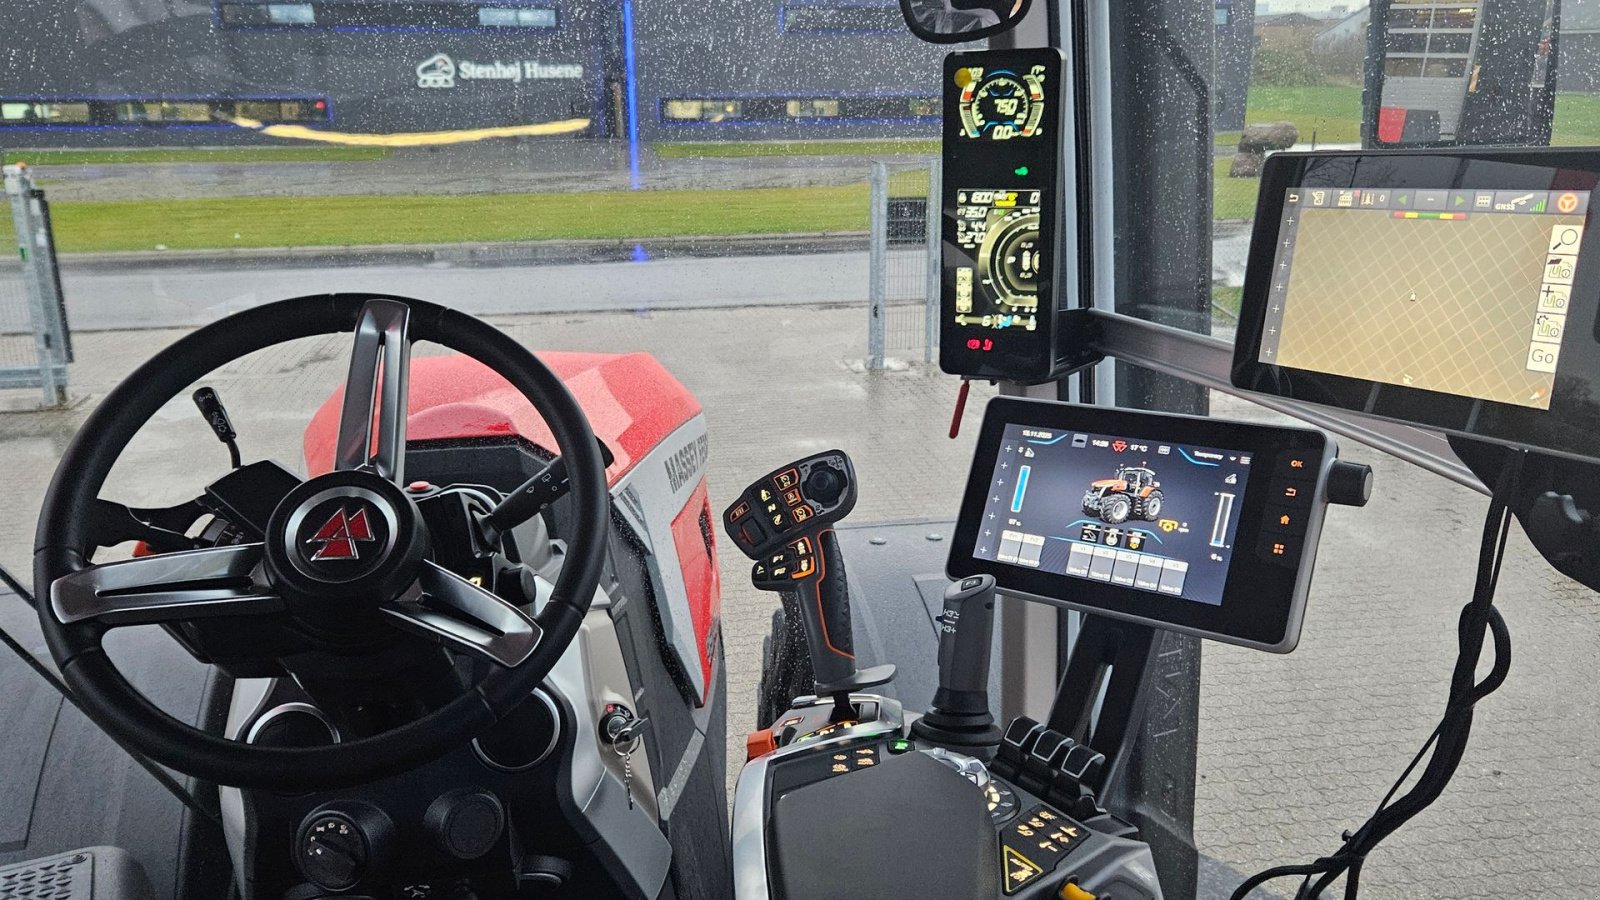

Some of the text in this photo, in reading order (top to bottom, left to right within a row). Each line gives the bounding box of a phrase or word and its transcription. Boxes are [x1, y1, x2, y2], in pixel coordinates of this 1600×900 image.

[459, 60, 583, 83] Stenhøj Husene
[994, 98, 1018, 115] 750
[1030, 192, 1040, 204] 0
[1495, 202, 1516, 211] GNSS
[1531, 348, 1554, 365] Go
[664, 440, 698, 495] MASSEY
[1290, 459, 1304, 468] OK
